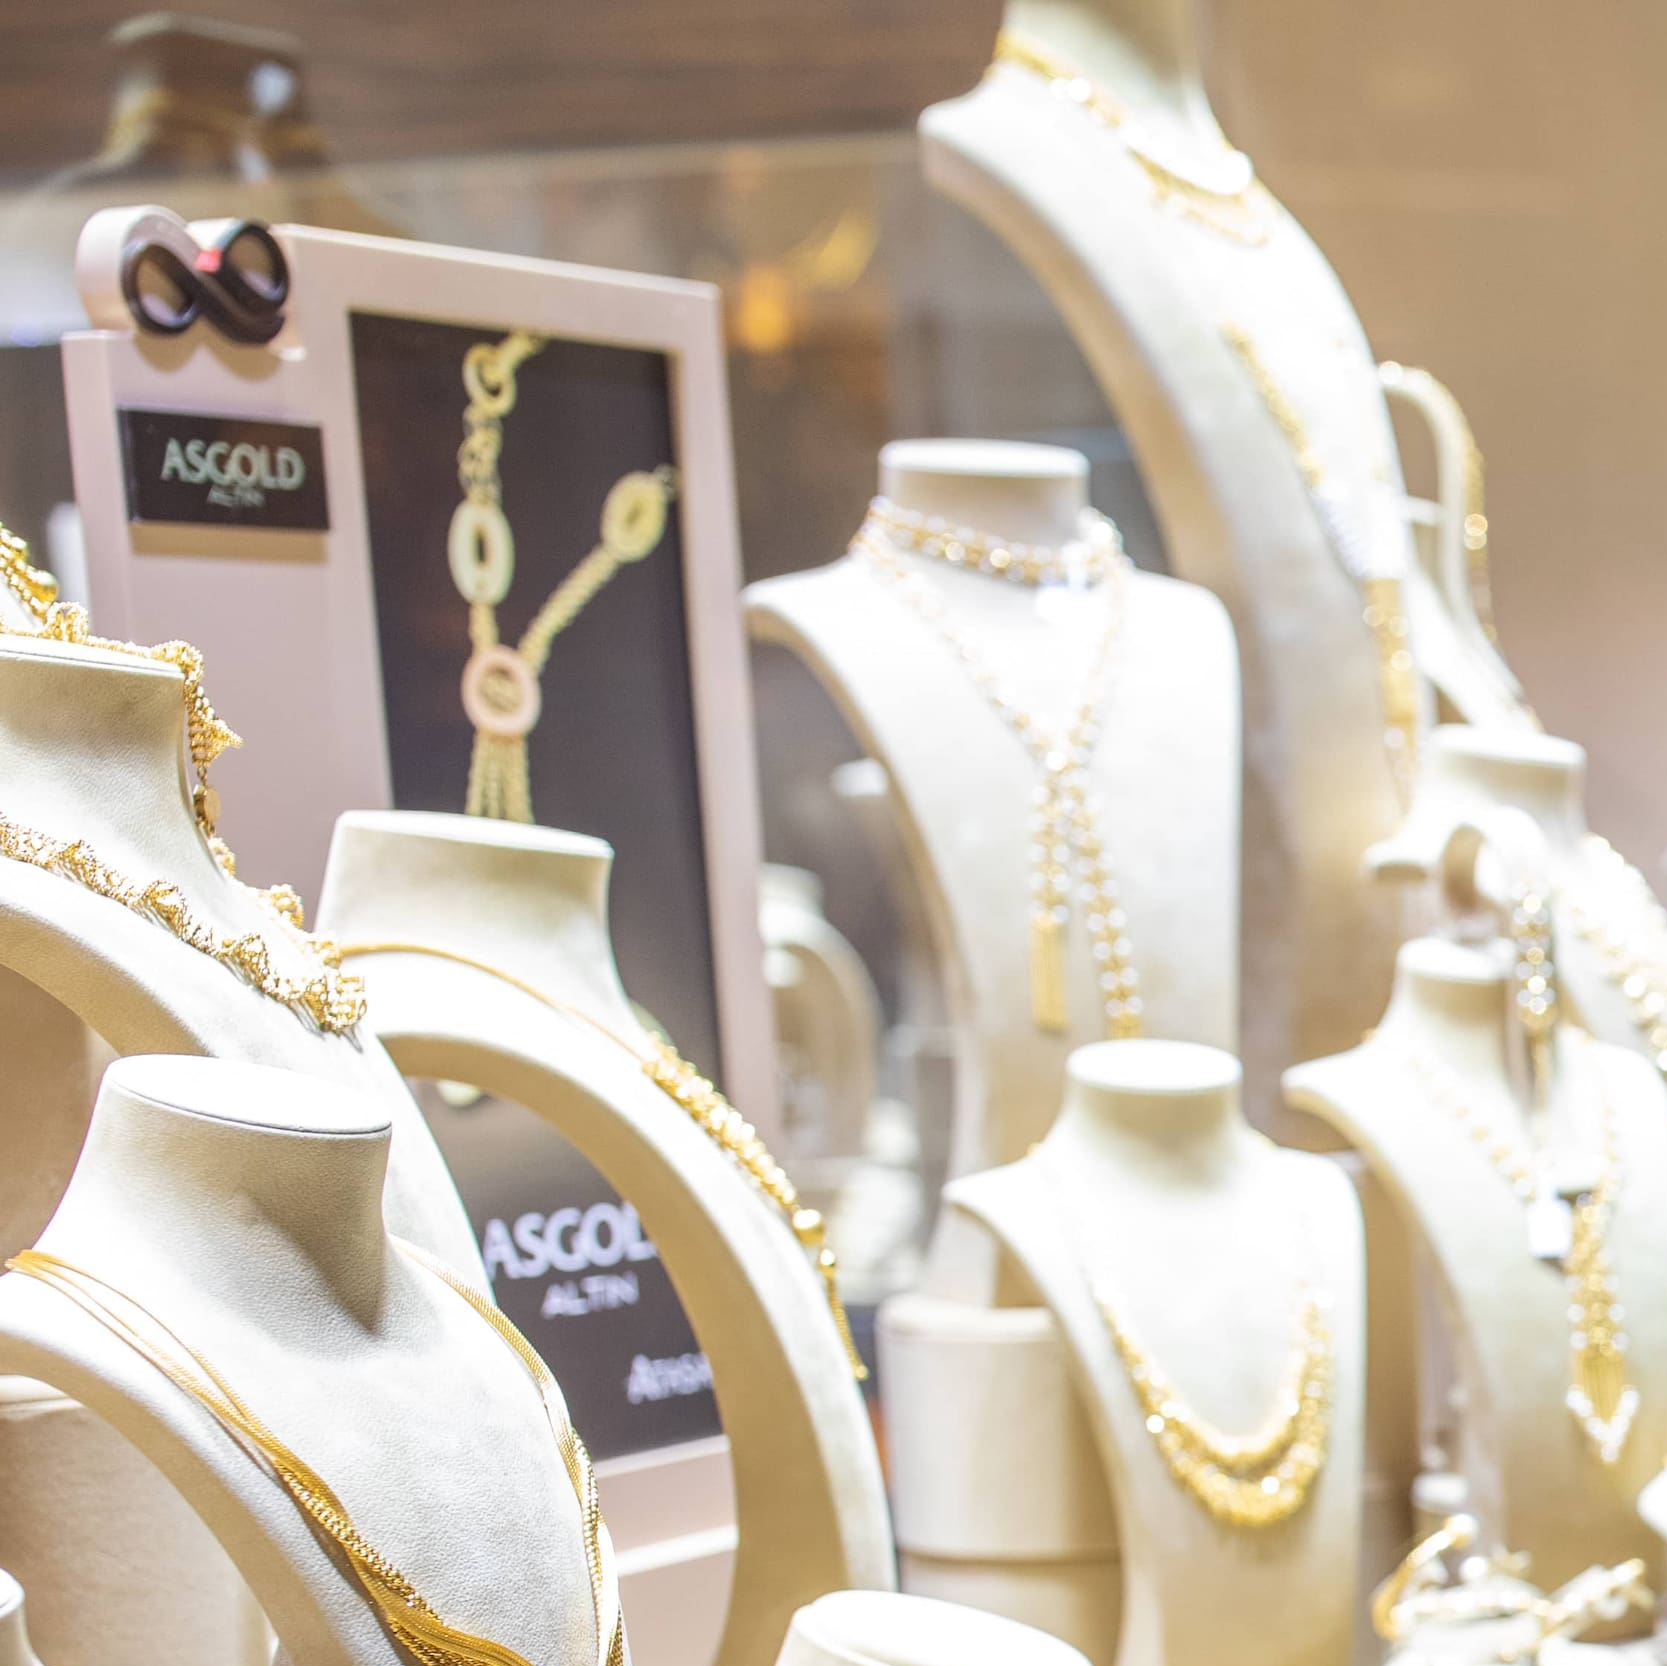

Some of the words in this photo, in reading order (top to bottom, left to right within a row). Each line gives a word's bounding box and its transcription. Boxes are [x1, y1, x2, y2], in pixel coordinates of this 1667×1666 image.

[161, 438, 306, 491] ASGOLD
[482, 1201, 659, 1281] ASGOL
[541, 1271, 641, 1320] ALTIN
